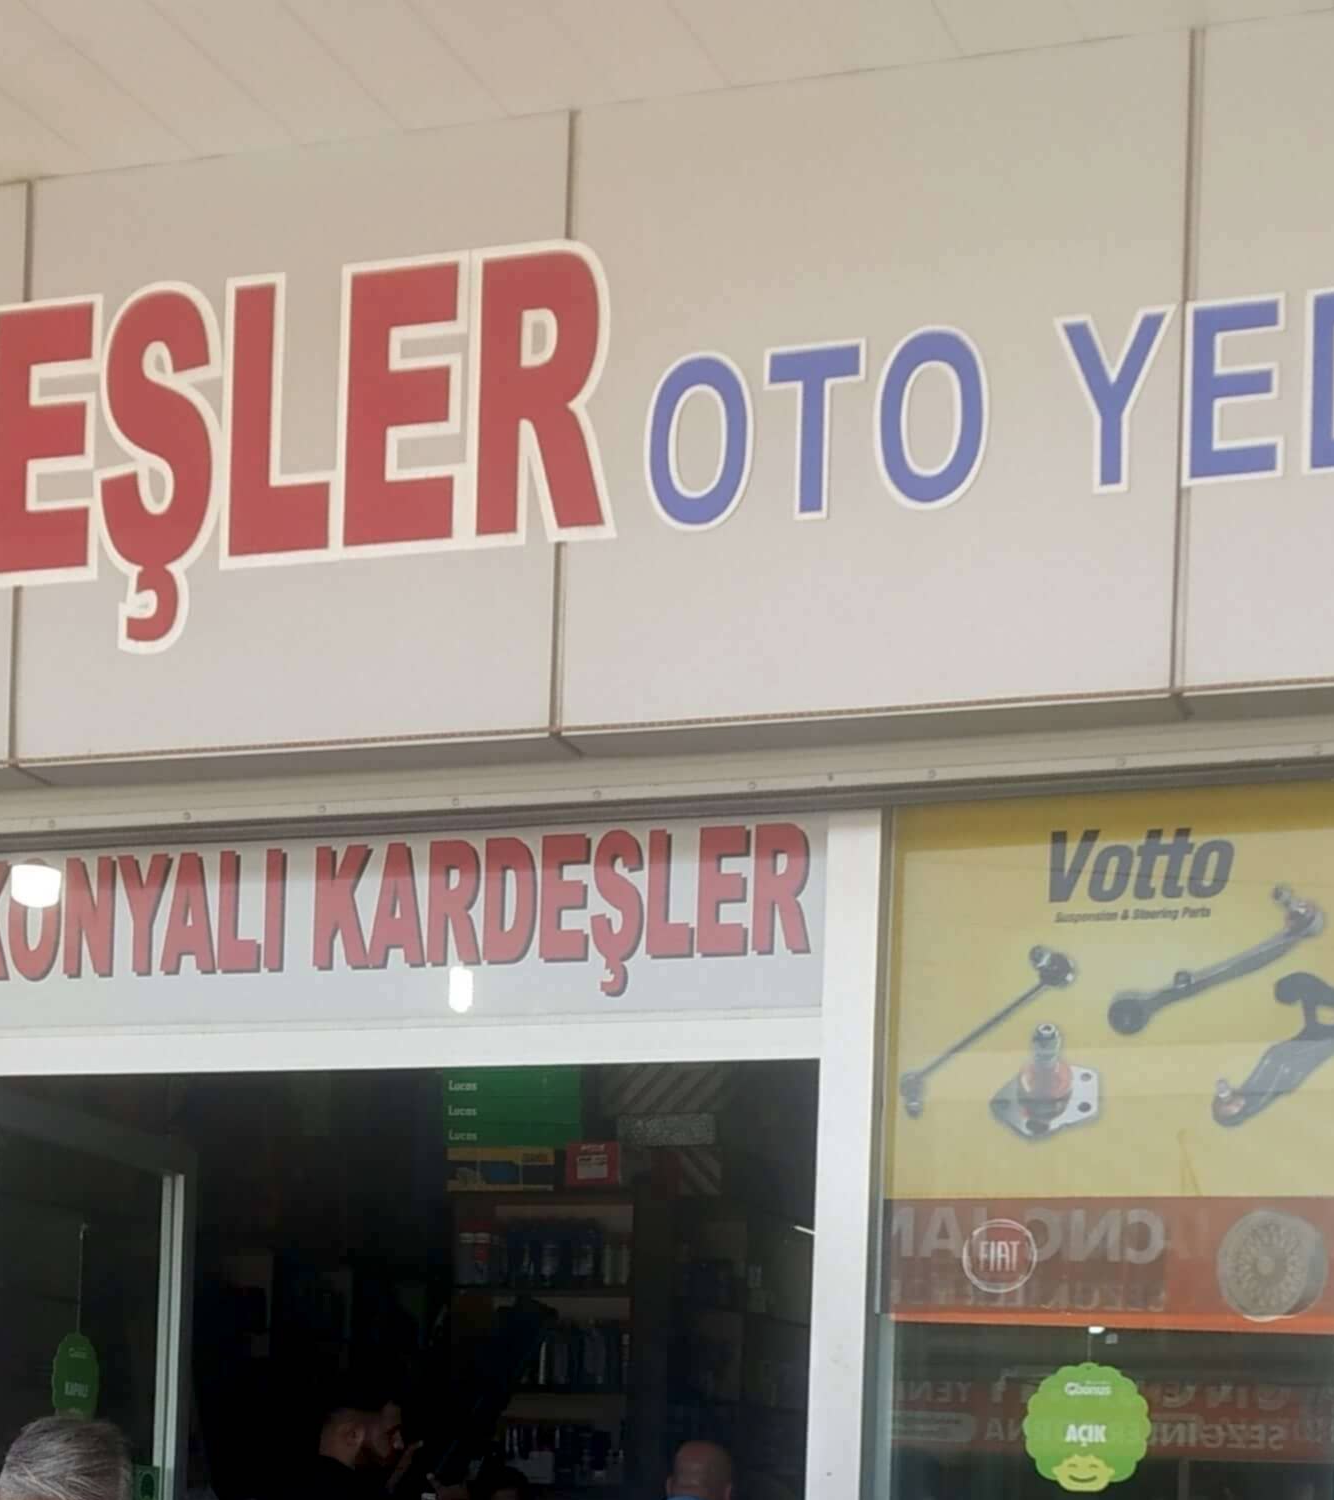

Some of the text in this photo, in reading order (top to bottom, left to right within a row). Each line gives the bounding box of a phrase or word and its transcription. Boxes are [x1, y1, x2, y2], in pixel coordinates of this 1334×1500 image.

[644, 324, 990, 532] OTO
[1047, 826, 1235, 903] Votto
[312, 821, 812, 997] KARDEŞLER
[448, 1080, 477, 1092] Lucas
[448, 1105, 477, 1117] Lucas
[978, 1241, 1021, 1272] FIAT
[1065, 1423, 1107, 1446] AÇIK
